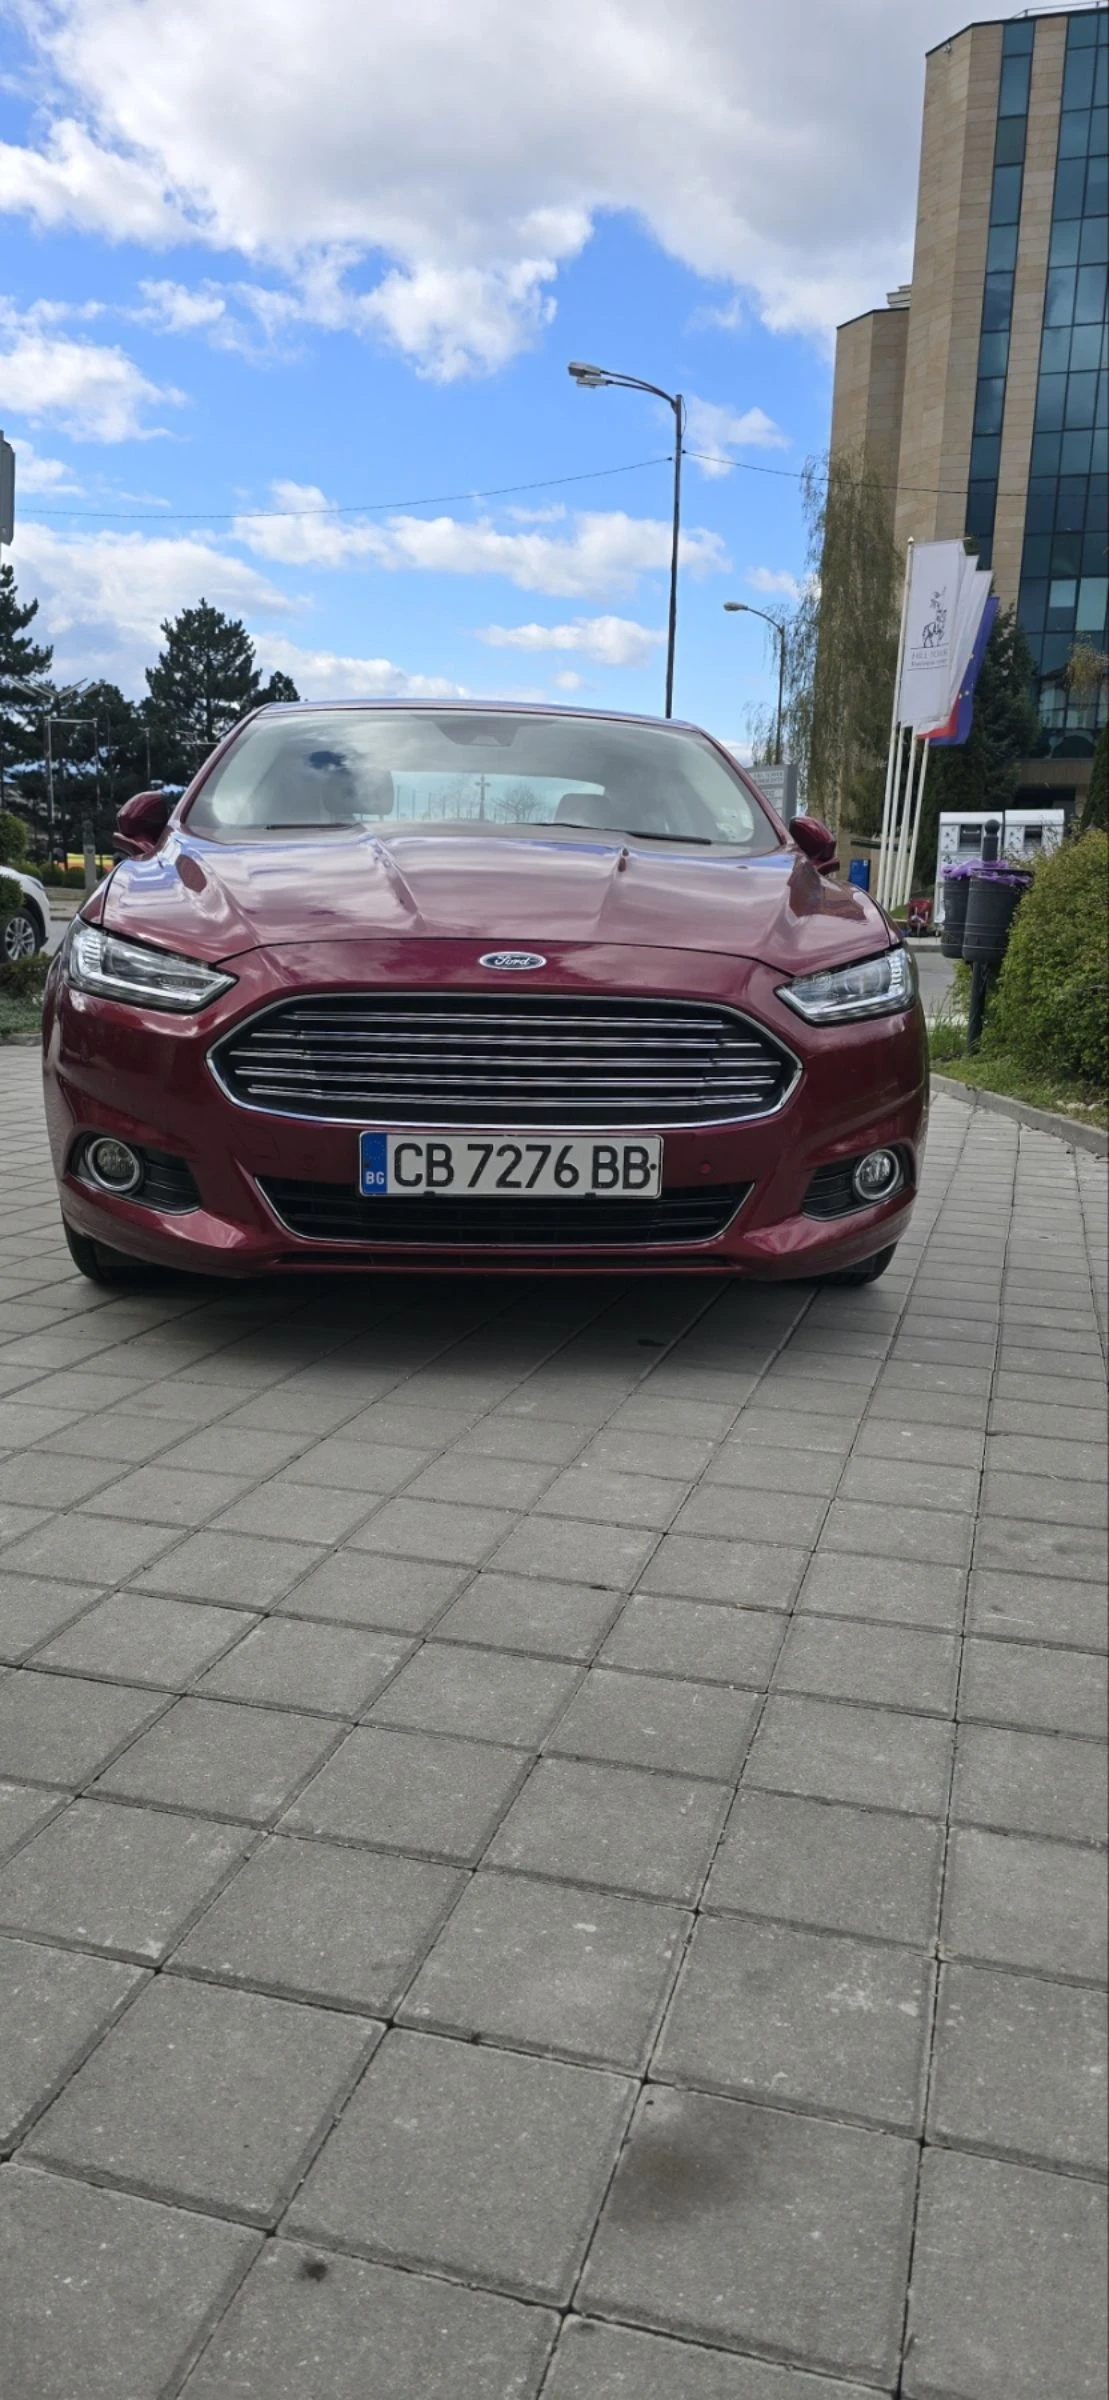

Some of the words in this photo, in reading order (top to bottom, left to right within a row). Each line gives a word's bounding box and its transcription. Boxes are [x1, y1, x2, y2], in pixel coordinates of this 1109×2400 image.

[494, 955, 530, 965] Ford
[394, 1143, 454, 1188] CB
[467, 1143, 580, 1189] 7276
[591, 1145, 651, 1190] BB
[365, 1171, 385, 1185] BG
